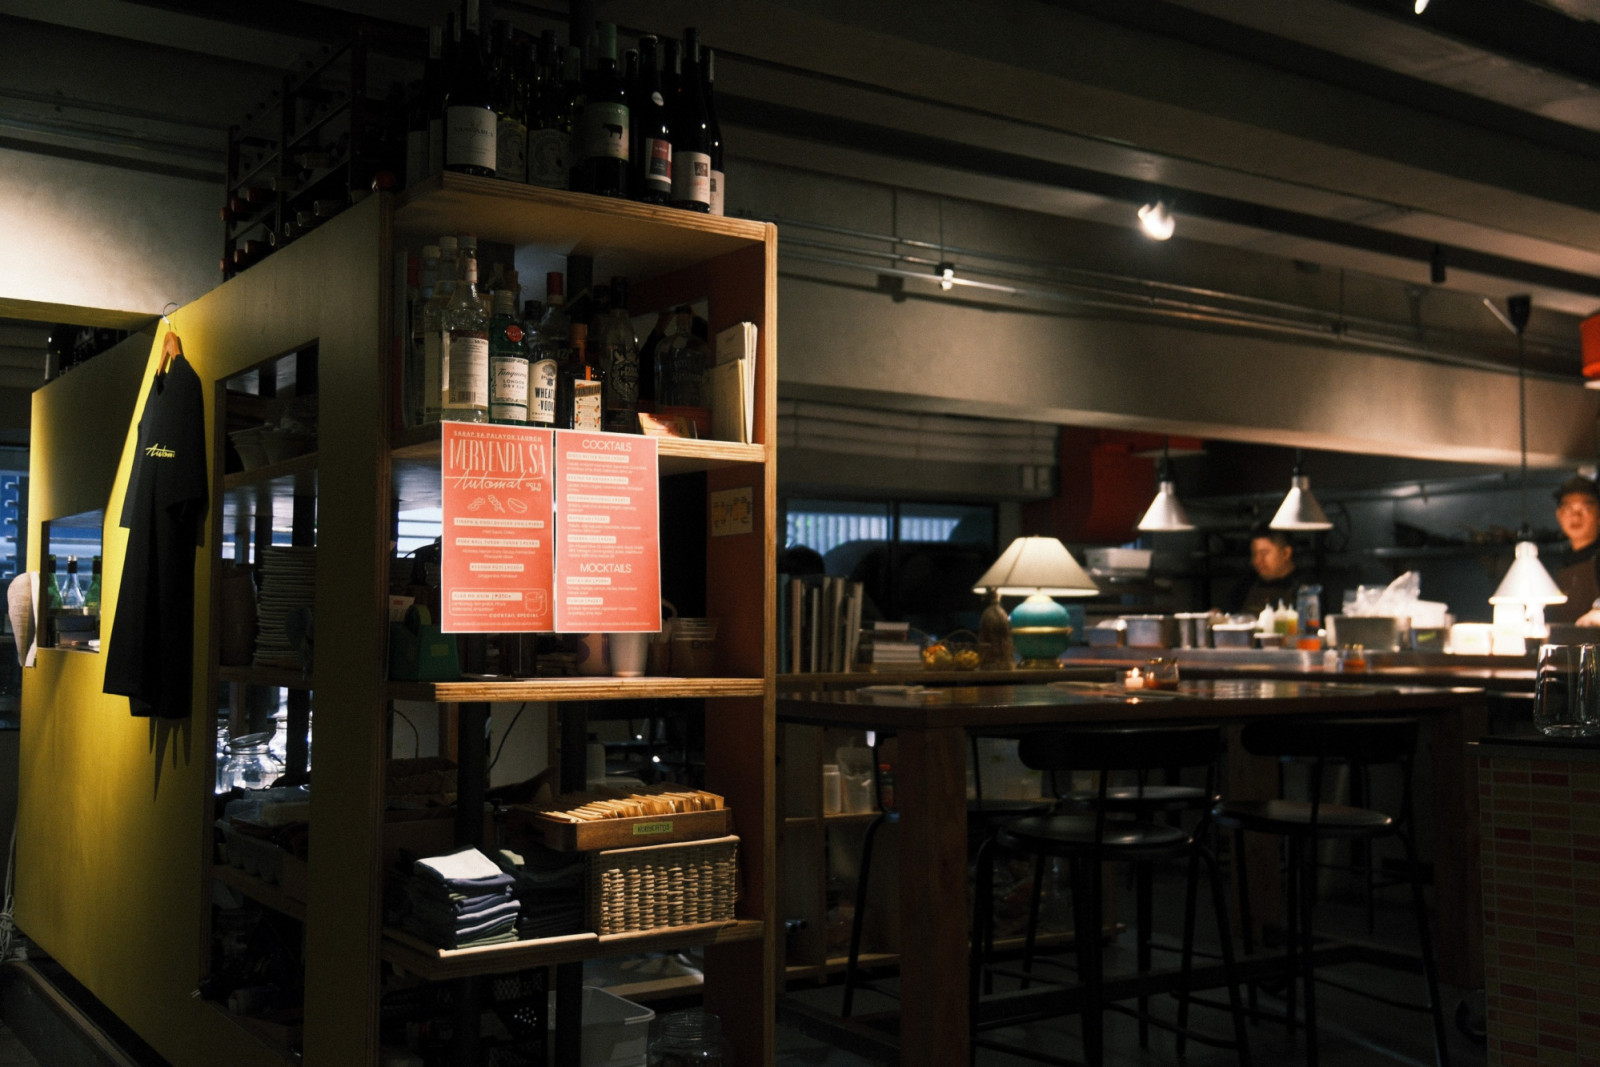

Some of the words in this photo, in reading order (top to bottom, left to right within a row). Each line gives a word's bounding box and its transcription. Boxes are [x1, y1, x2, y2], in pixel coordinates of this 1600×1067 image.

[582, 439, 633, 452] COCKTAILS
[449, 438, 525, 473] MERYENDA
[529, 443, 546, 475] SA
[449, 468, 532, 490] Automat
[580, 563, 632, 573] MOCKTAILS
